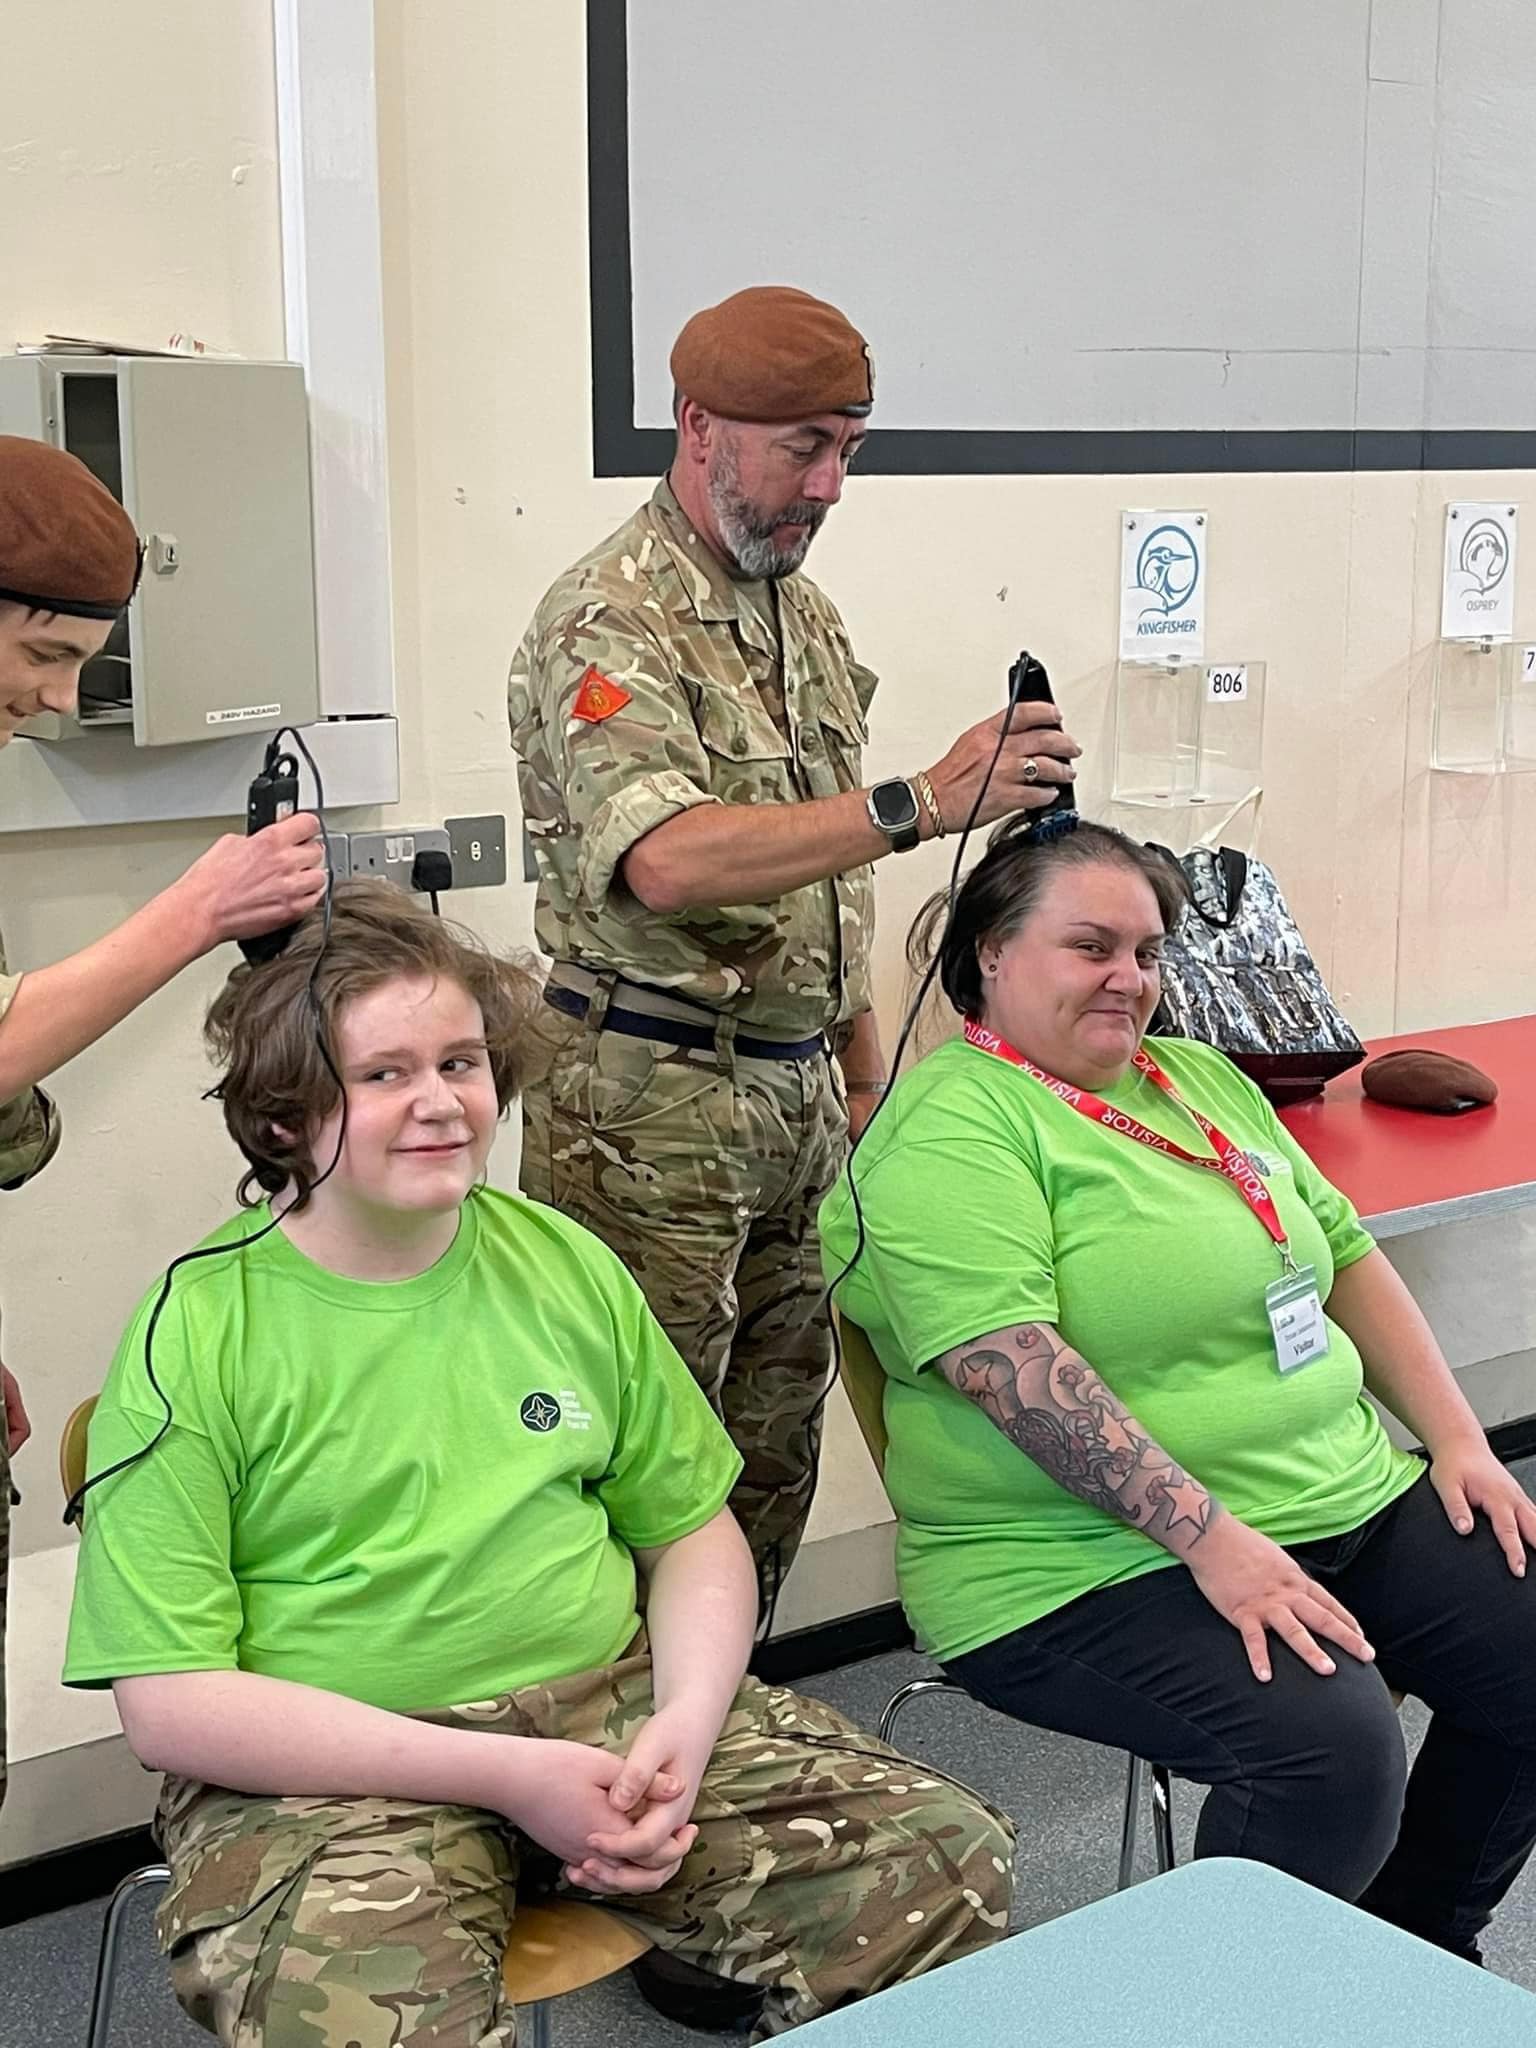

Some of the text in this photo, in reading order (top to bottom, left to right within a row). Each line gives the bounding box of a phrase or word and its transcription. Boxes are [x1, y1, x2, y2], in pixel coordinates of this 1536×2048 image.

[1466, 599, 1500, 612] OSPREY
[1136, 619, 1197, 636] KINGFISHER
[1213, 673, 1242, 693] 806
[1018, 1060, 1081, 1106] VISITOR
[1101, 1107, 1169, 1150] VISITOR
[1222, 1145, 1268, 1203] VISITOR
